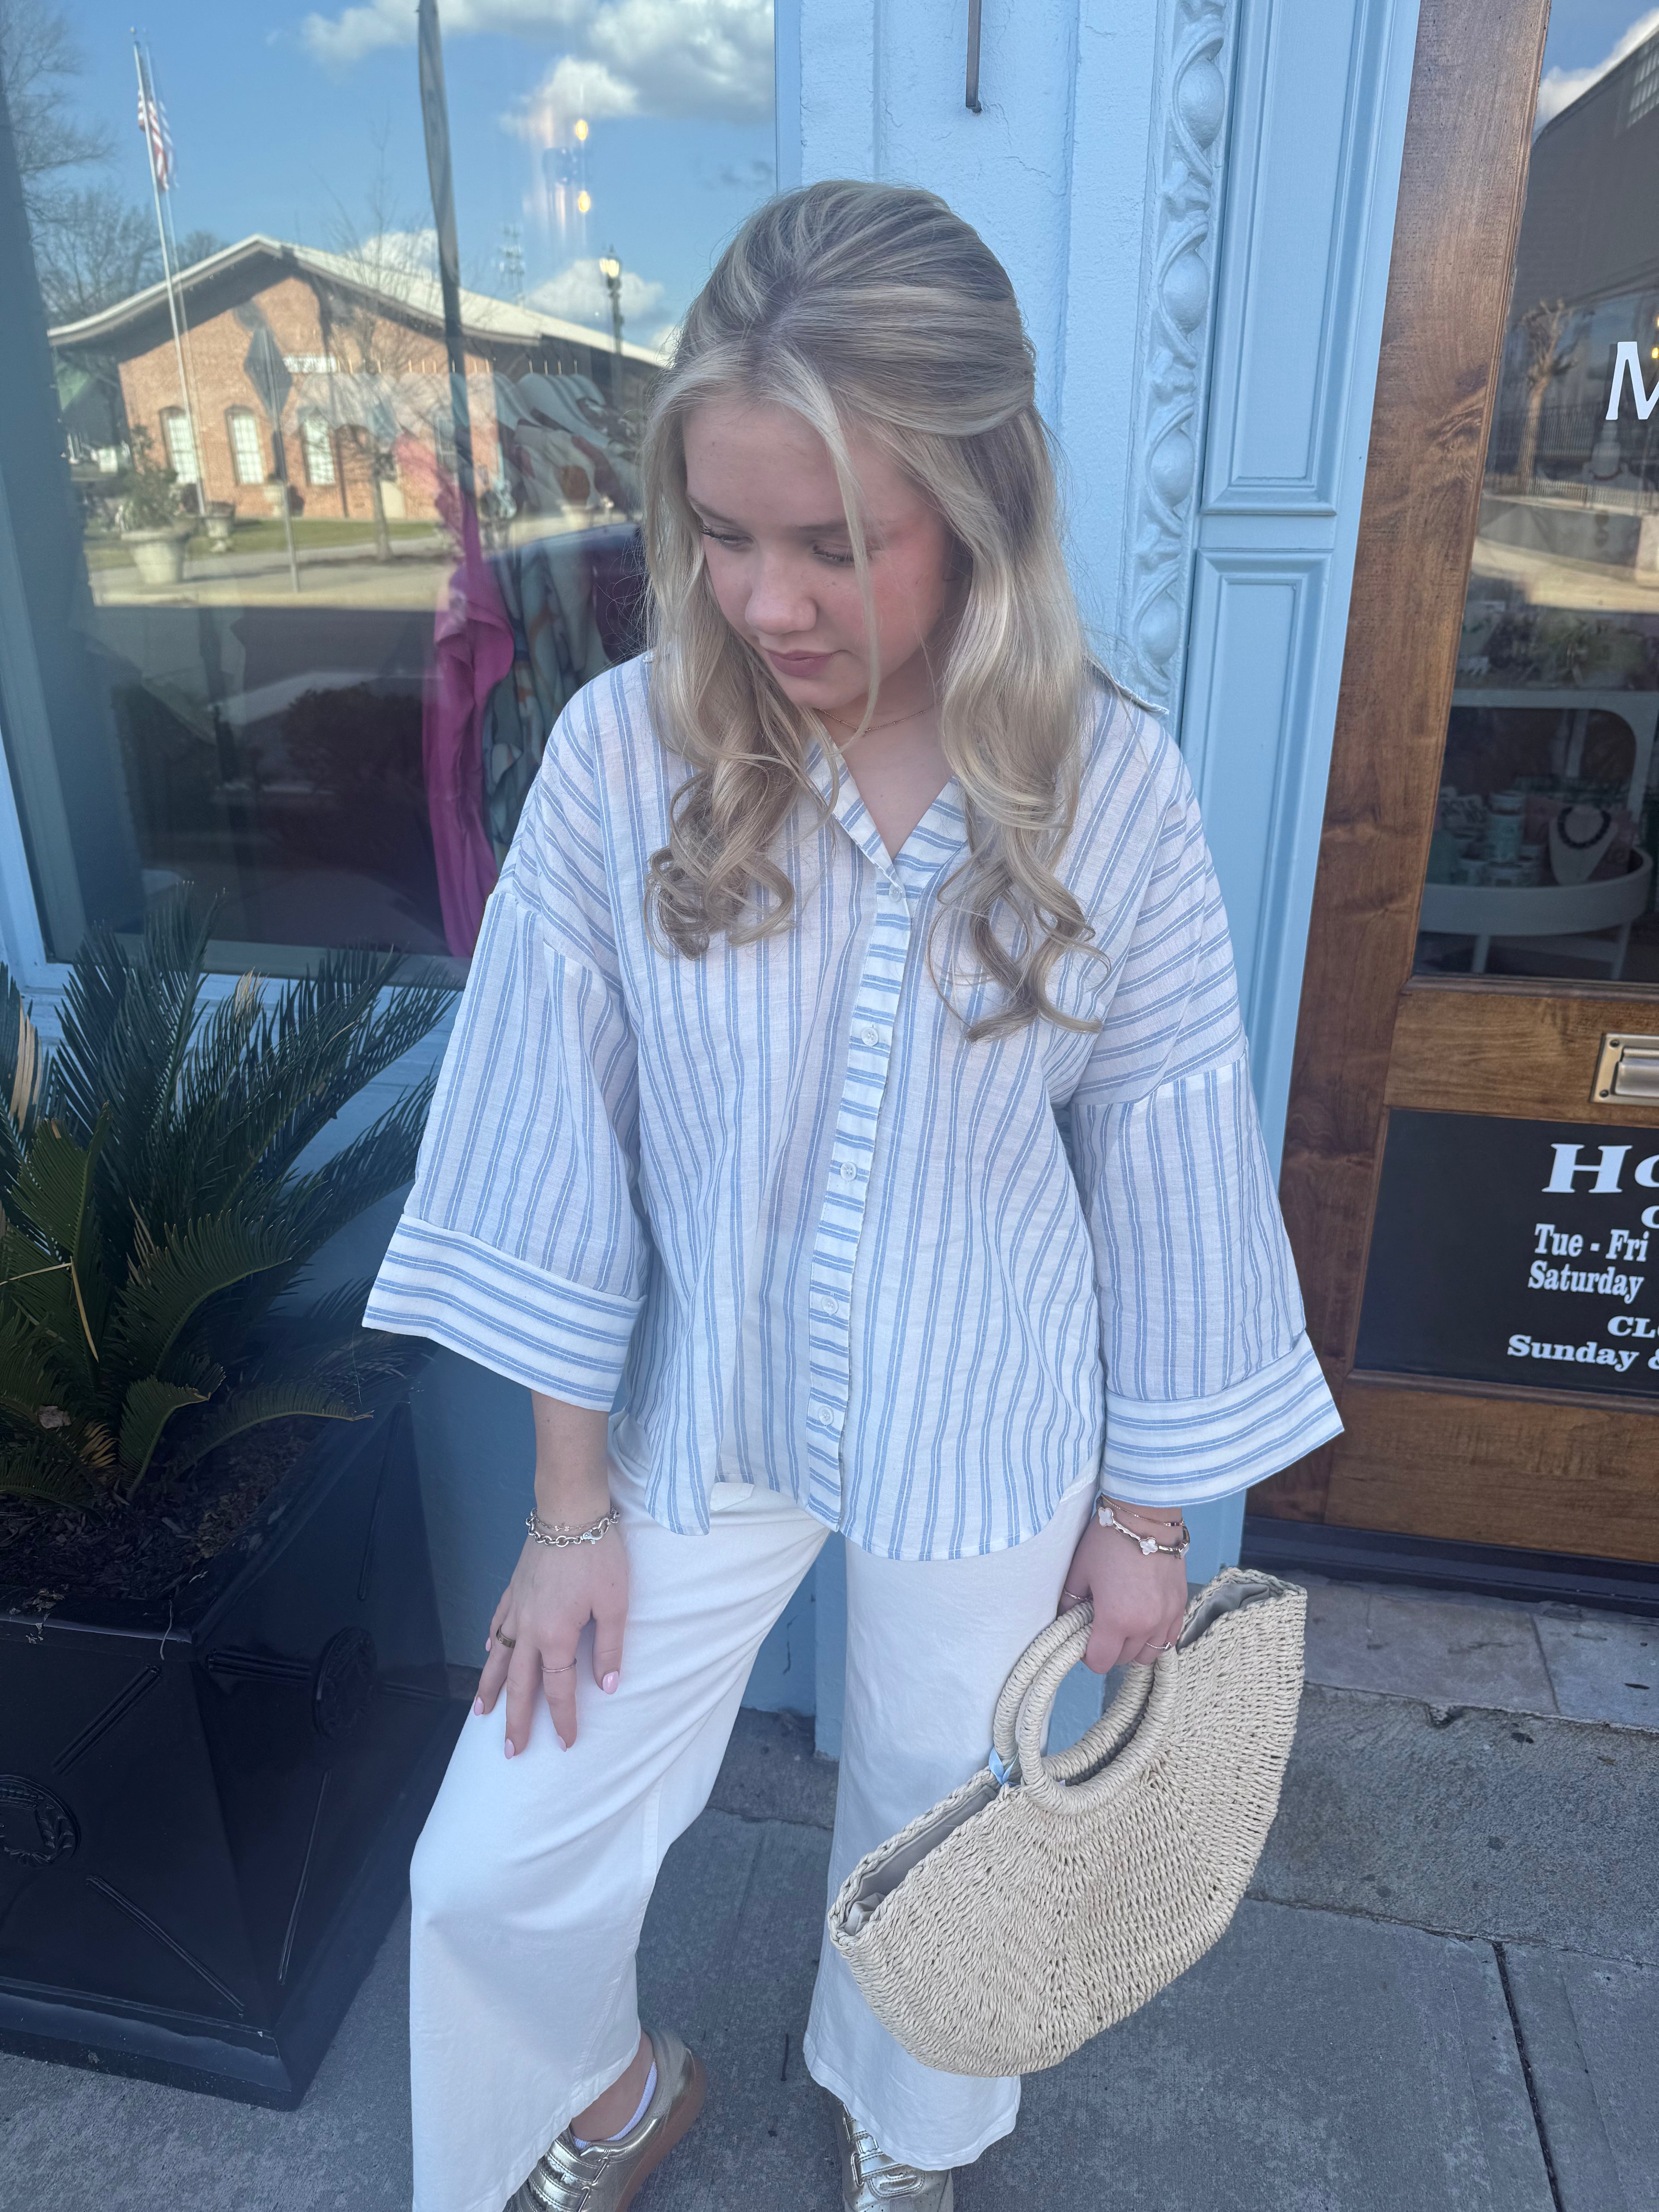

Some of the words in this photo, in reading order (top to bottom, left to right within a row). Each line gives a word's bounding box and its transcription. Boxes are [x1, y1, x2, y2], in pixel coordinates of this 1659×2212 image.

[1534, 1223, 1583, 1257] Tue
[1590, 1243, 1600, 1252] -
[1605, 1229, 1649, 1262] Fri
[1527, 1259, 1645, 1304] Saturday
[1607, 1316, 1659, 1338] CL
[1507, 1335, 1640, 1372] Sunday
